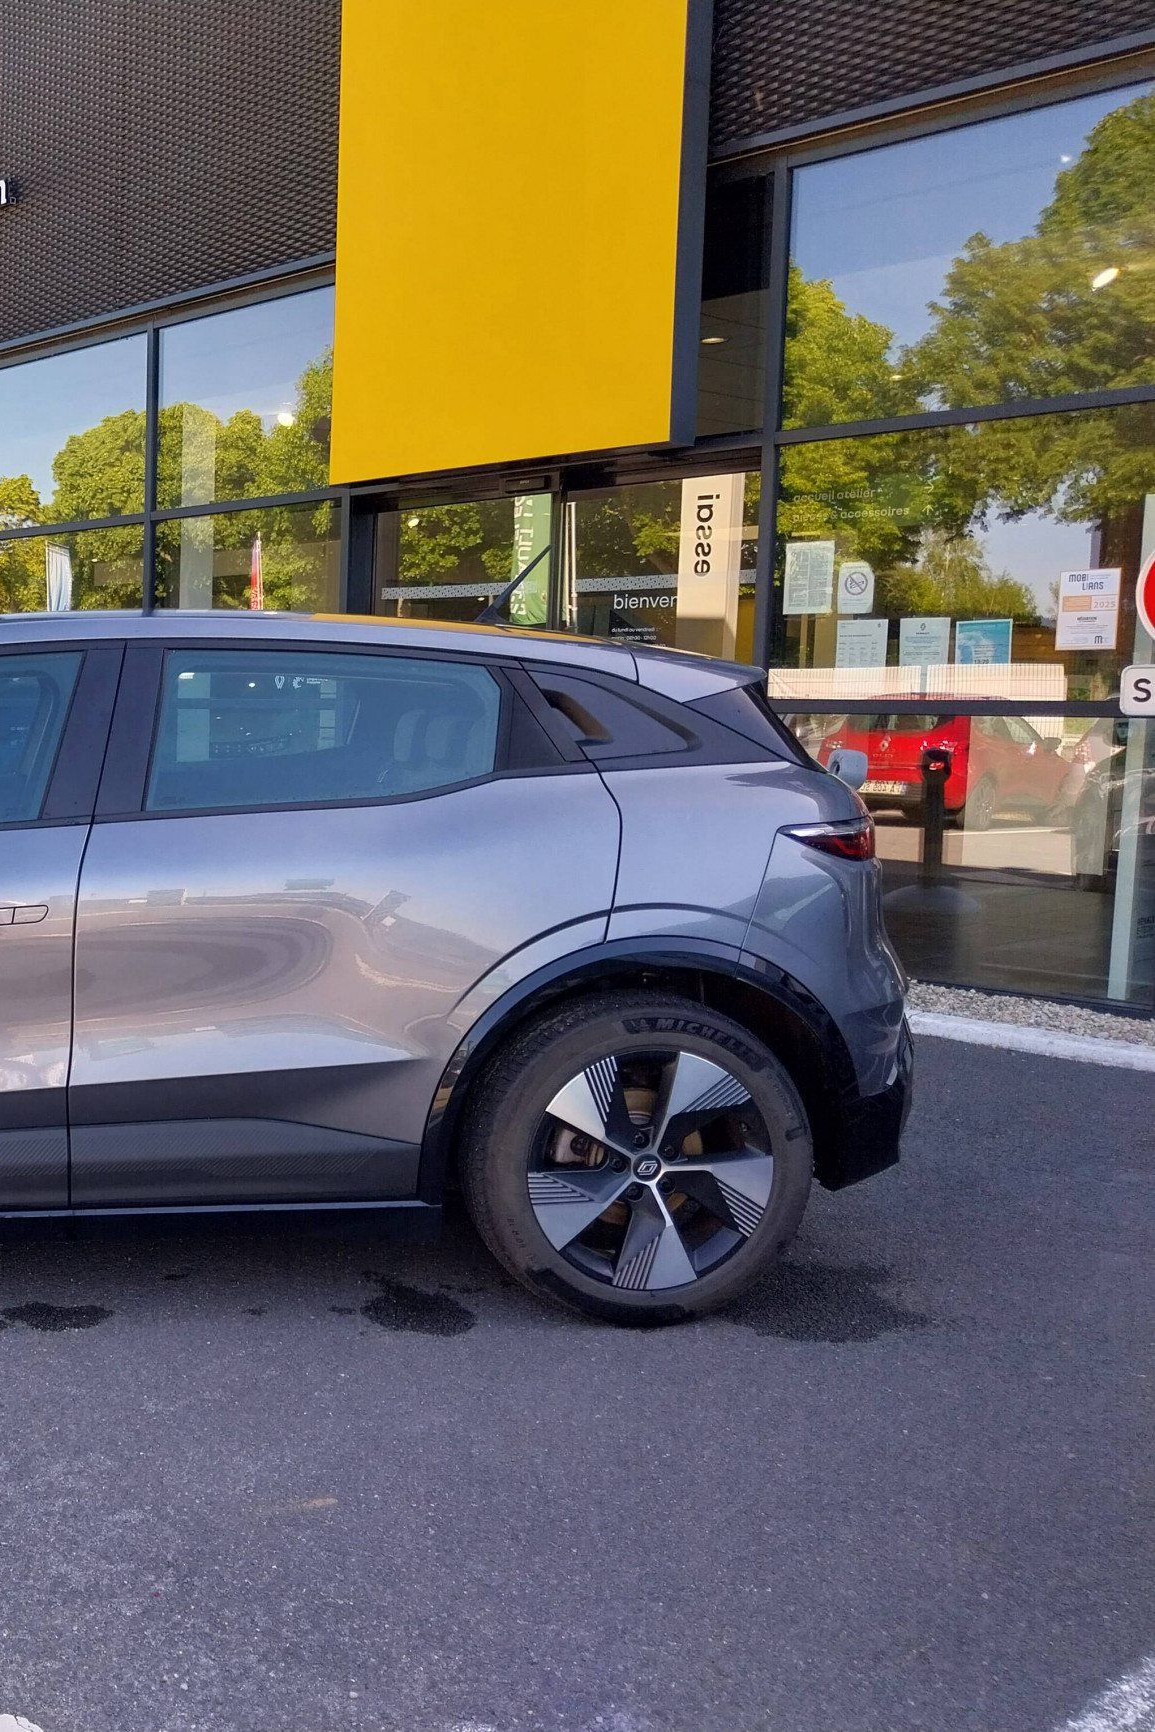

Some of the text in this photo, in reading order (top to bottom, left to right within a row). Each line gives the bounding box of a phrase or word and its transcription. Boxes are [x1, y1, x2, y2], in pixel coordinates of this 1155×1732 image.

[792, 488, 876, 502] accueil atelier
[840, 505, 910, 519] accessoires
[1093, 601, 1116, 609] 2025
[656, 1017, 762, 1064] MICHELIN
